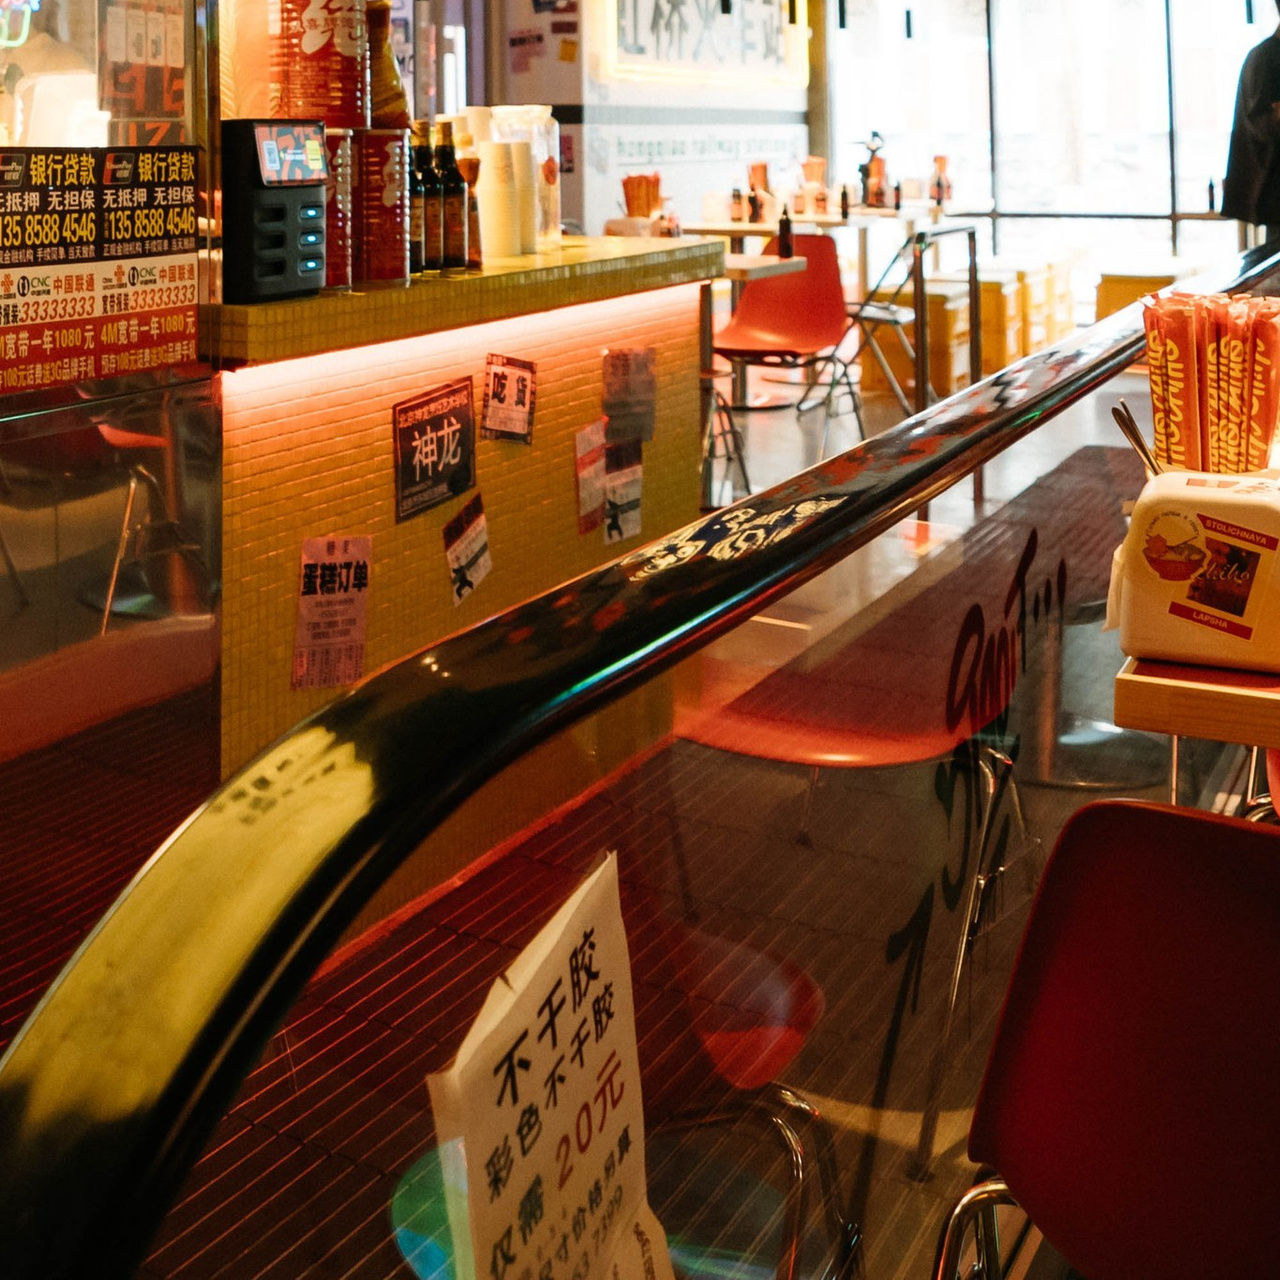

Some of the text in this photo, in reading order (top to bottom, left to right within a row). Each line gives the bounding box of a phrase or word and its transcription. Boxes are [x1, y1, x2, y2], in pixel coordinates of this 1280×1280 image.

[30, 154, 95, 186] 银行贷款
[138, 151, 194, 183] 银行贷款
[47, 190, 95, 210] 无担保
[103, 185, 194, 208] 无抵押 无担保
[25, 214, 59, 245] 8588
[62, 212, 95, 242] 4546
[109, 206, 194, 240] 135 8588 4546
[53, 273, 94, 295] 中国联通
[412, 416, 461, 482] 神龙
[1205, 519, 1267, 545] STOLICHNAYA
[301, 560, 368, 596] 蛋糕订单
[1192, 610, 1229, 629] LAPSHA
[493, 927, 600, 1107] 不干胶
[484, 981, 615, 1204] 彩色不干胶
